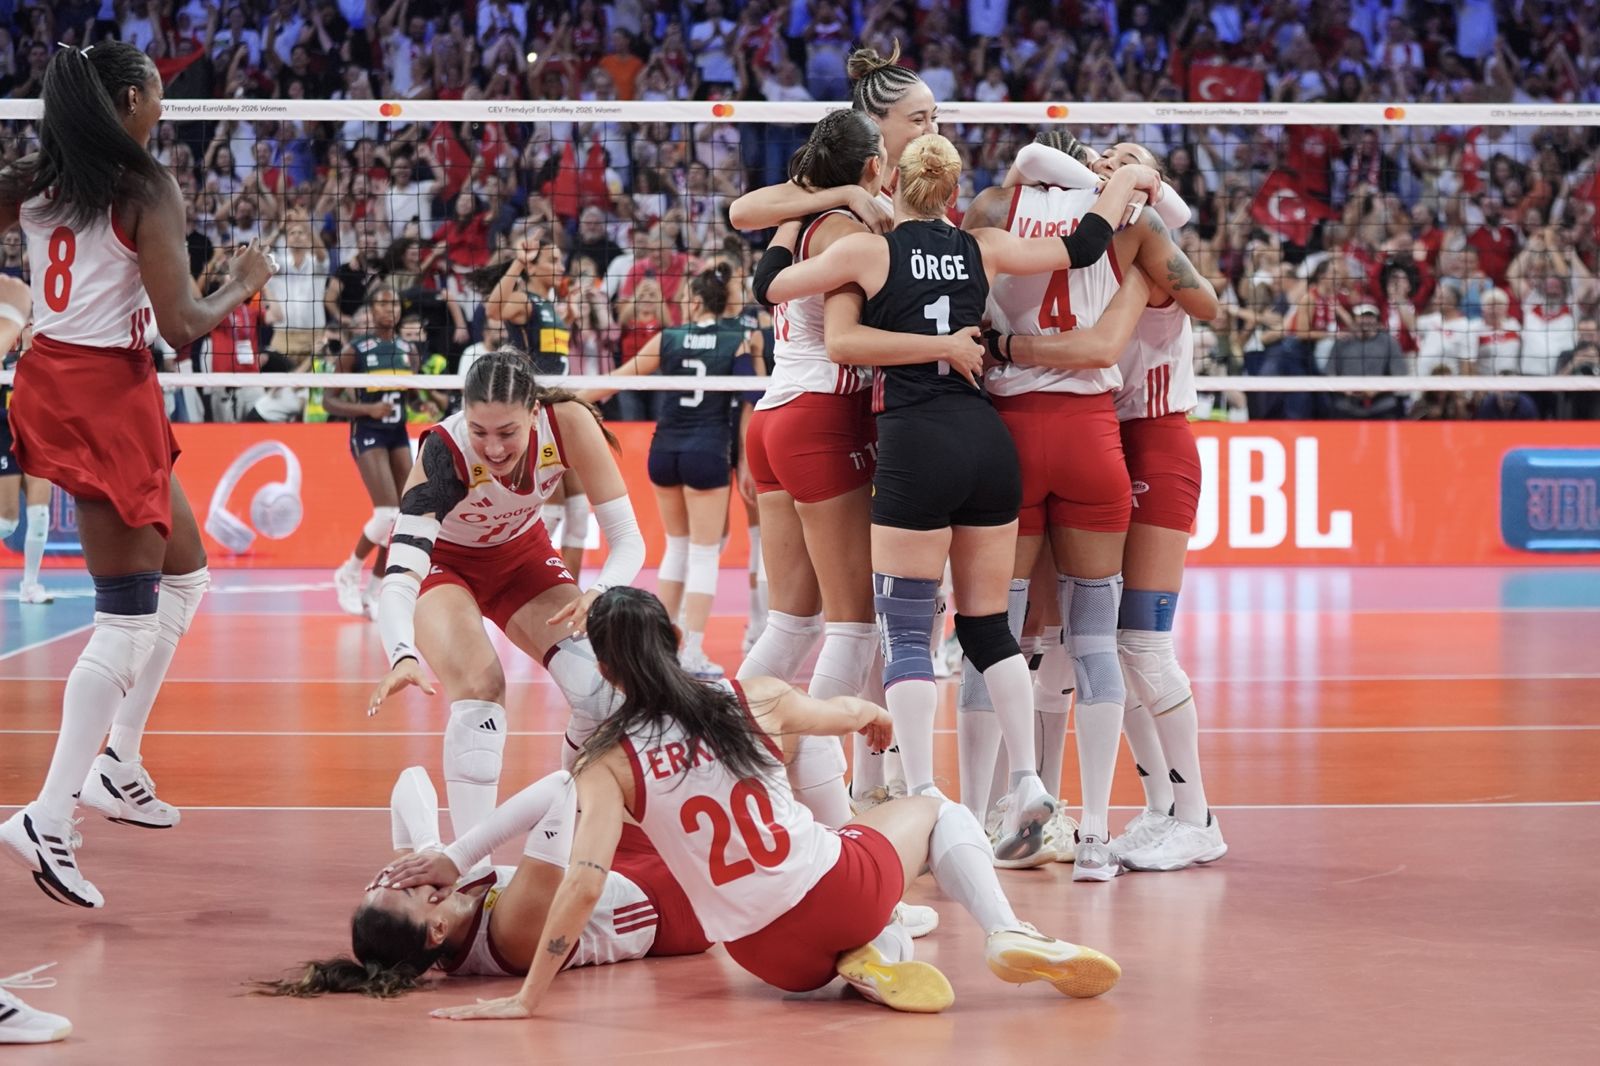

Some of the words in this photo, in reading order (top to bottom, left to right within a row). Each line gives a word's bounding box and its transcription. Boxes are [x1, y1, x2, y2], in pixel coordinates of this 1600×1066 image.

[171, 105, 201, 113] Trendyol
[203, 105, 240, 113] EuroVolley
[505, 106, 535, 115] Trendyol
[537, 106, 574, 115] EuroVolley
[1018, 217, 1080, 238] VARGA
[44, 226, 76, 313] 8
[911, 249, 969, 281] ÖRGE
[1038, 268, 1077, 332] 4
[924, 295, 951, 375] 1
[679, 359, 707, 408] 3
[473, 466, 482, 476] S
[543, 447, 553, 457] S
[1187, 436, 1353, 550] JBL
[646, 737, 716, 780] ERK
[680, 777, 791, 886] 20
